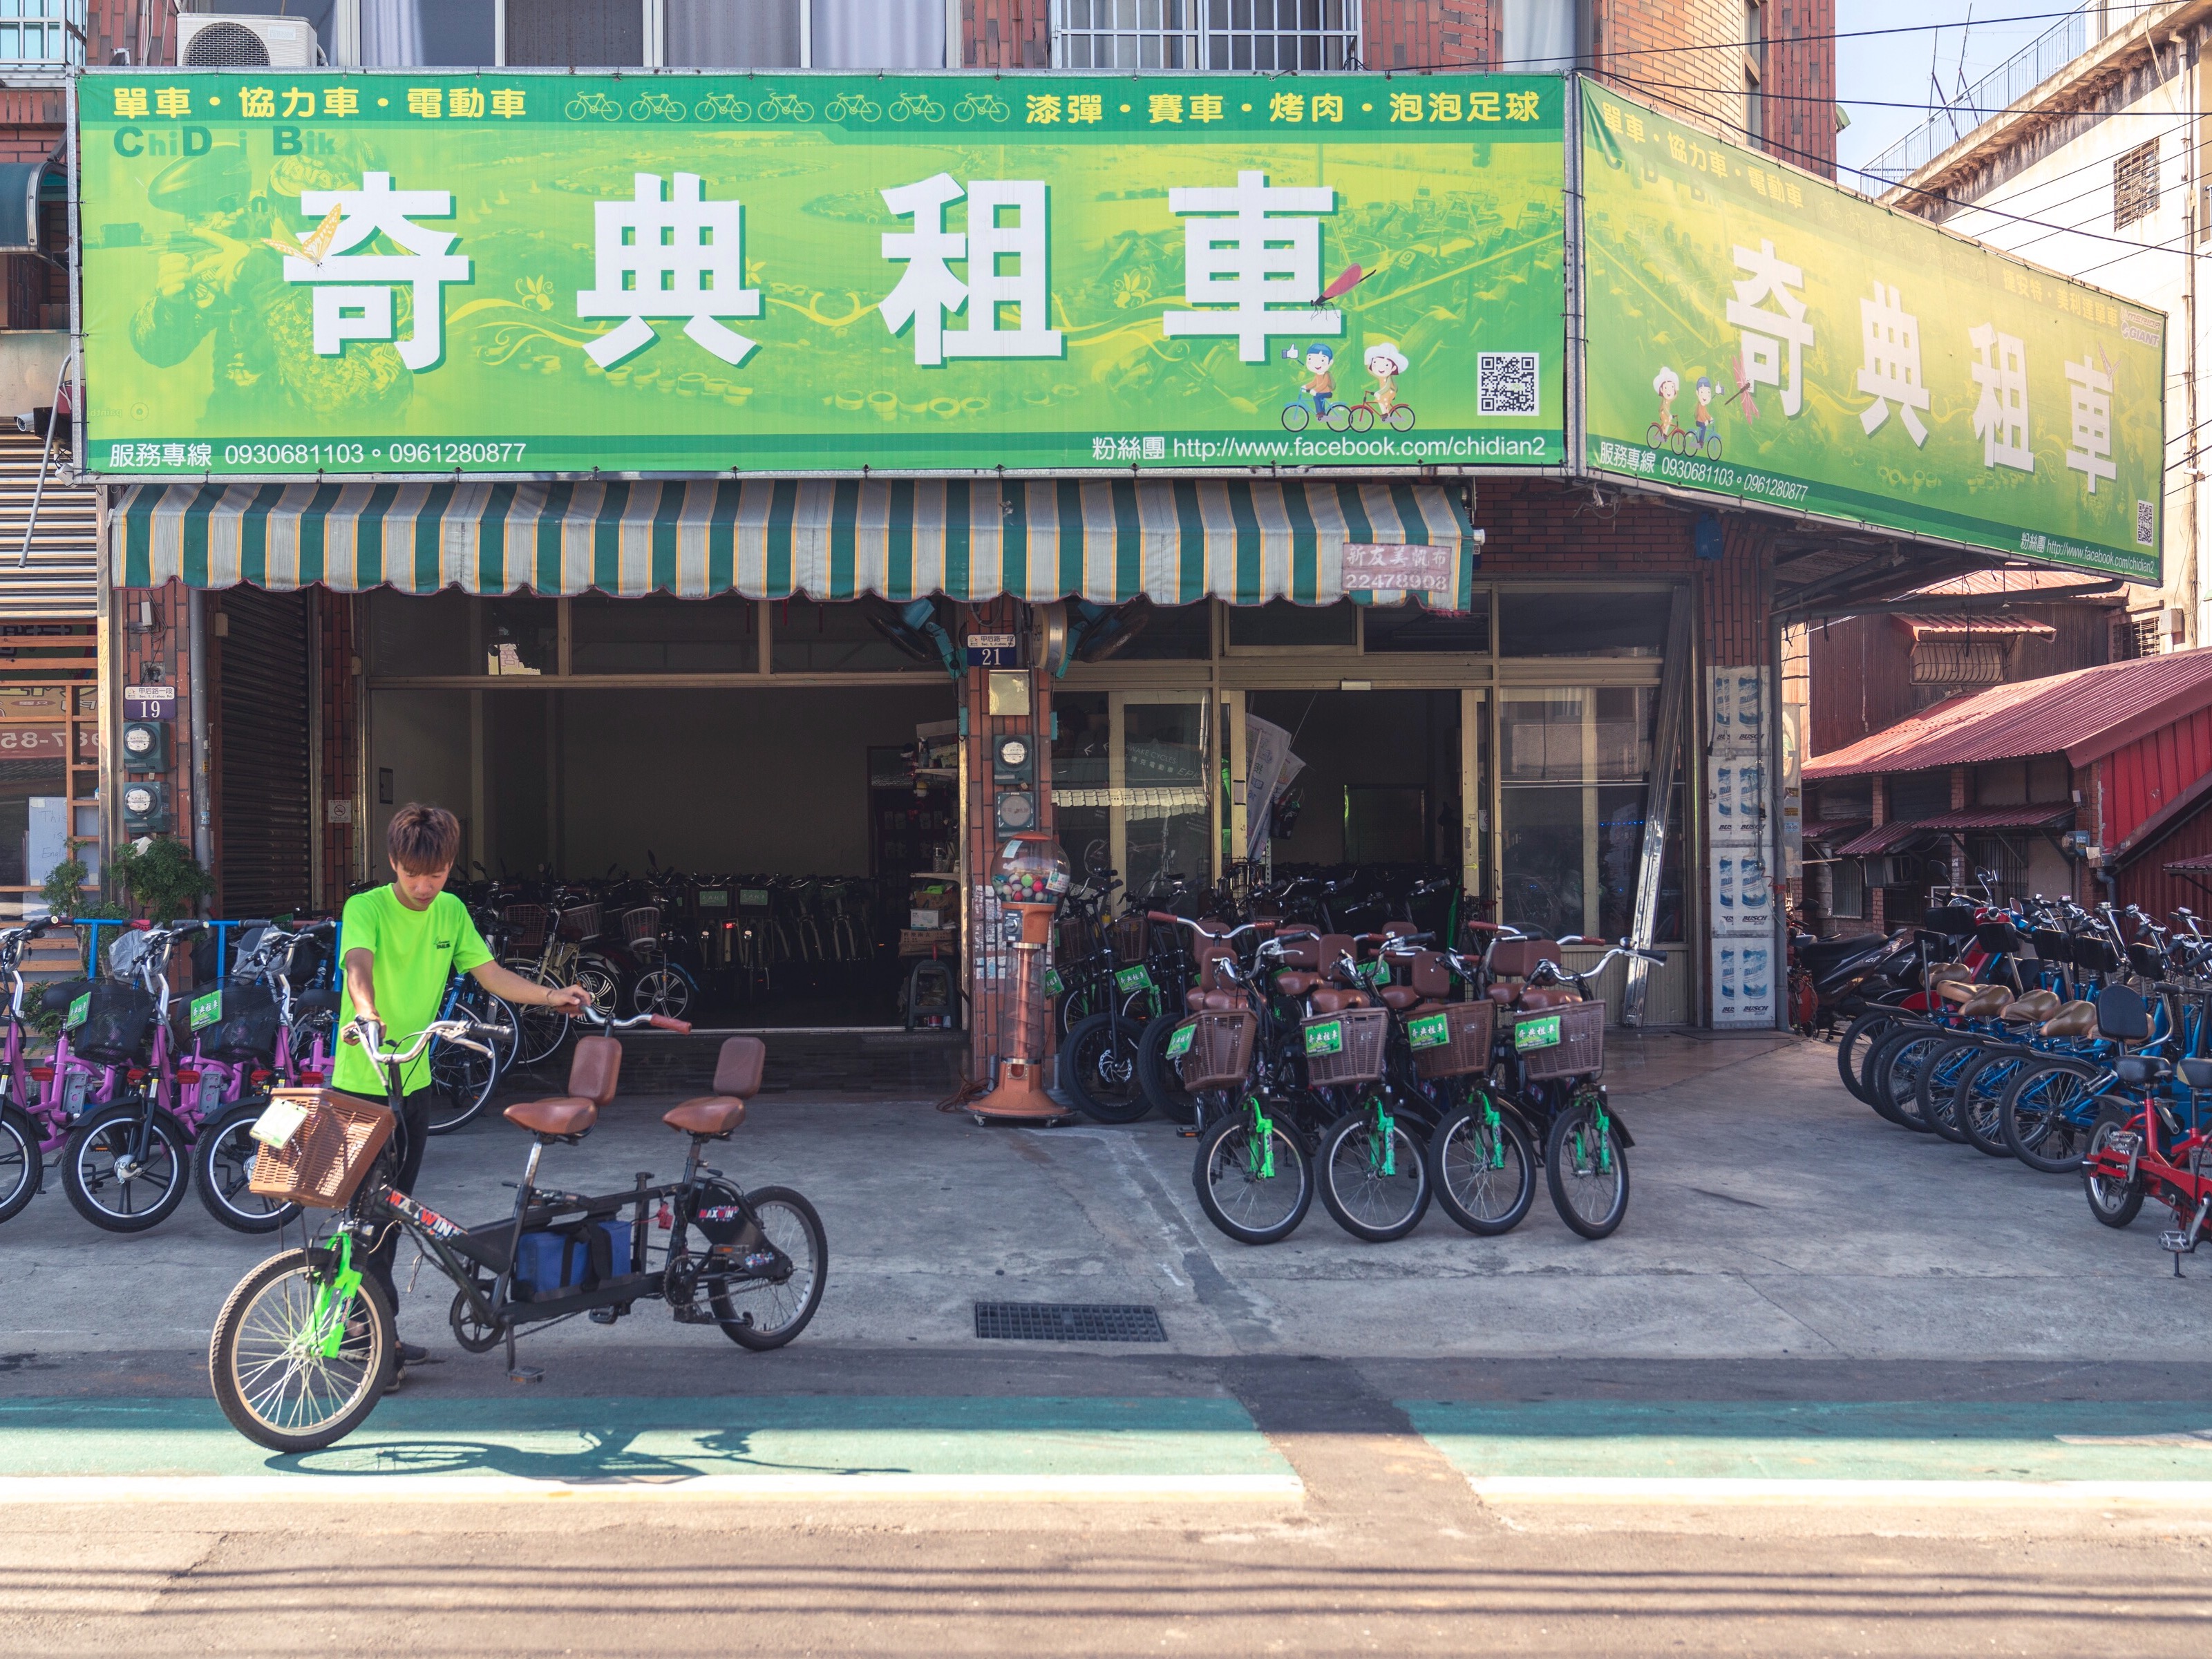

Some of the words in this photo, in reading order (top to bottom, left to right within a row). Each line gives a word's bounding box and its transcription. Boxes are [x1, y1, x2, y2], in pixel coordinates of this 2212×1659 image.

[283, 171, 1342, 373] 奇典租車
[2128, 327, 2159, 348] GIANT
[1726, 238, 2119, 493] 奇典租車
[109, 443, 211, 468] 服務專線
[1092, 437, 1166, 461] 粉絲團
[1173, 437, 1546, 462] http://www.facebook.com/chidian2
[1599, 442, 1656, 474] 服務專線
[2020, 531, 2046, 553] 粉絲團
[2047, 539, 2155, 575] http://www.facebook.com/chidian2
[981, 648, 1001, 665] 21
[140, 700, 161, 718] 19
[1151, 751, 1178, 764] CYCLES
[41, 847, 67, 864] Engli
[698, 1208, 736, 1219] MAXWIN
